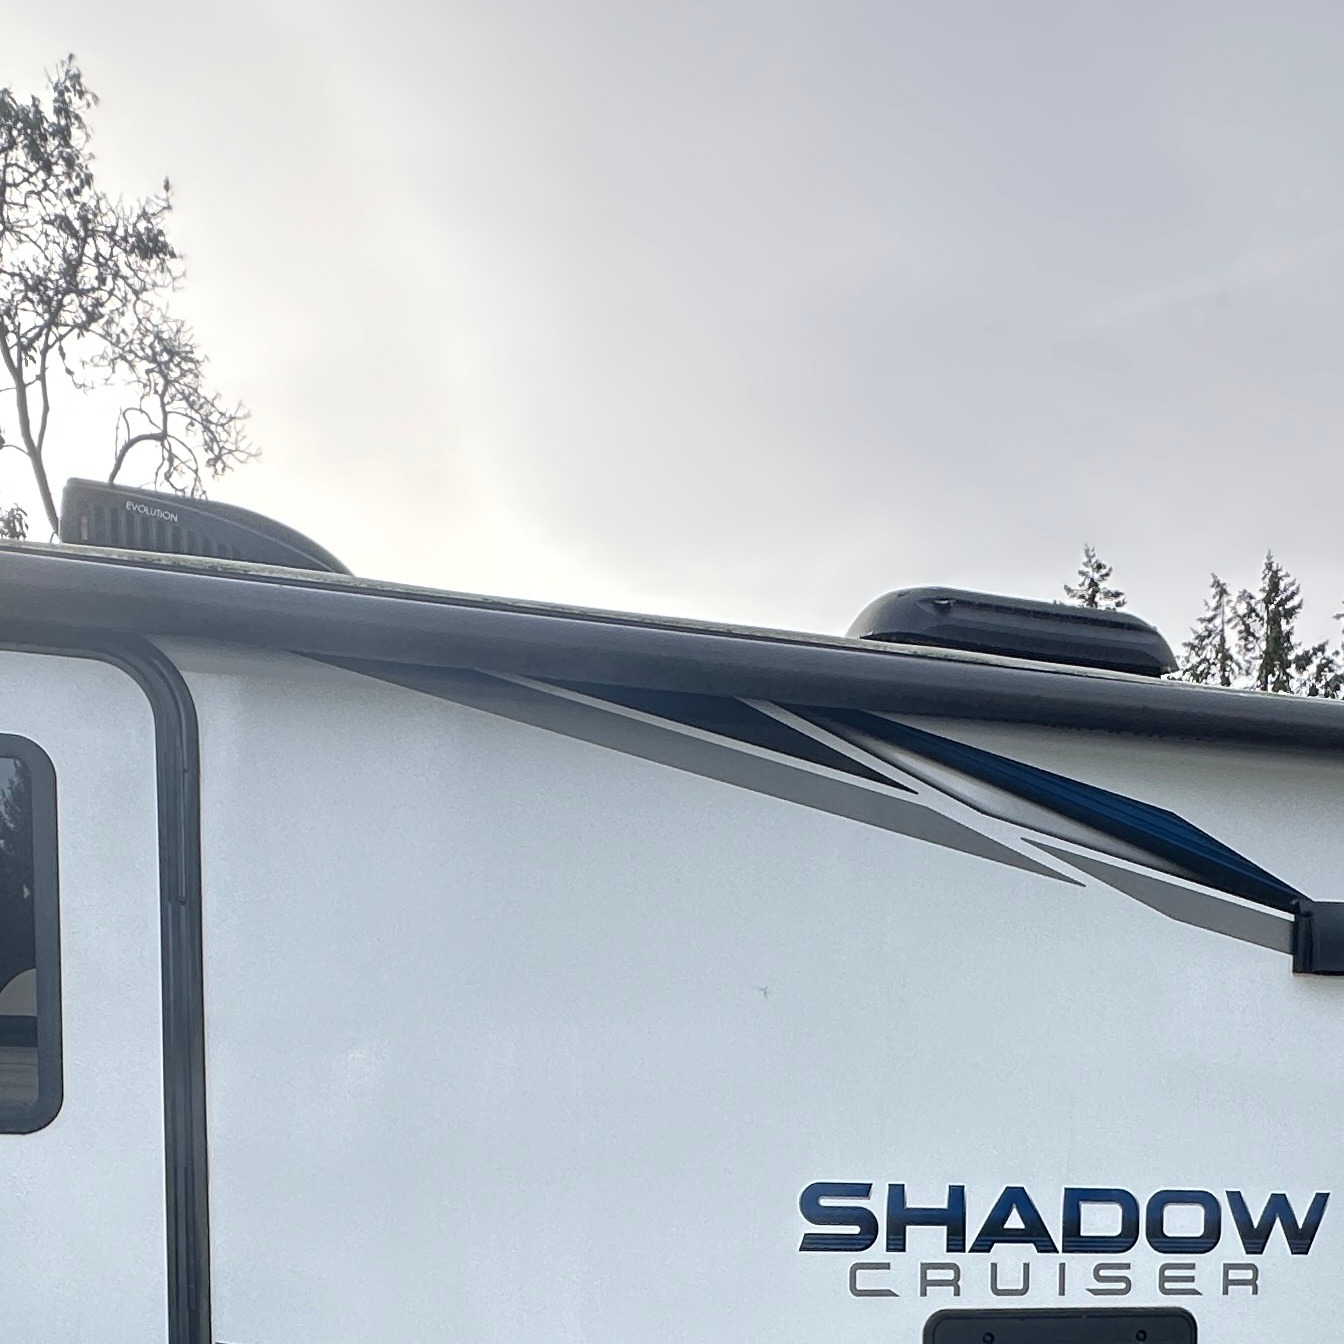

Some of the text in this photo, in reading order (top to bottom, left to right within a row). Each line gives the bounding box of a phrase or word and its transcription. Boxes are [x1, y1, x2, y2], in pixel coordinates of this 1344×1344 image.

[125, 500, 178, 522] EVOLUTION
[798, 1181, 1331, 1255] SHADOW
[848, 1261, 1259, 1298] CRUISER
